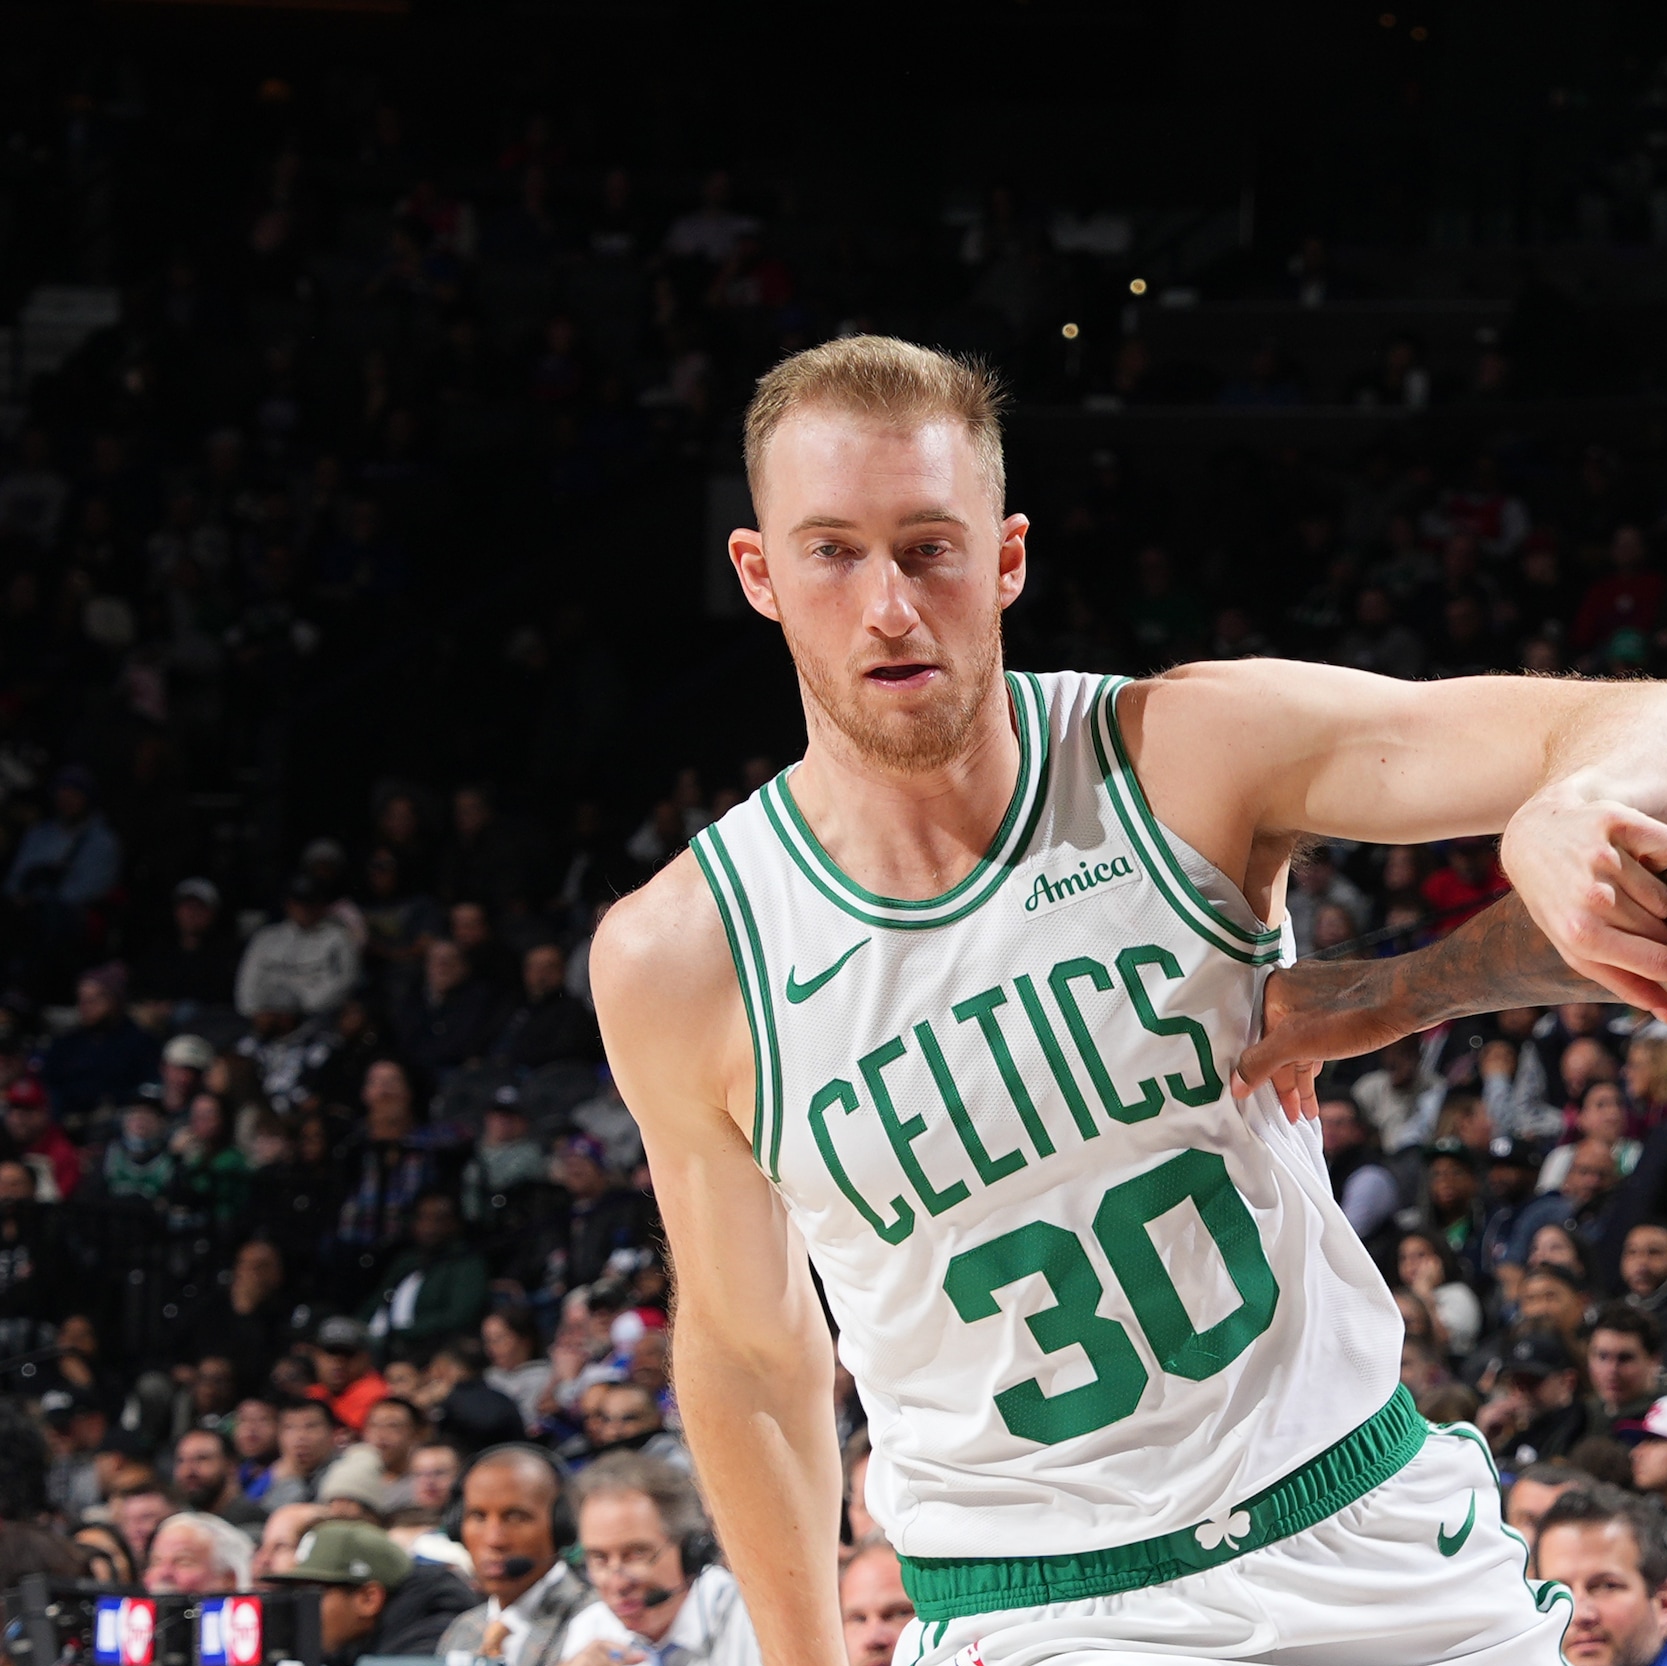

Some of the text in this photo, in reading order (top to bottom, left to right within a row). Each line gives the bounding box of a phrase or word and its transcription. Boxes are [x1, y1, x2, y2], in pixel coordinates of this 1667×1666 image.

[1022, 852, 1135, 913] Amica
[807, 945, 1225, 1247] CELTICS
[942, 1147, 1281, 1446] 30
